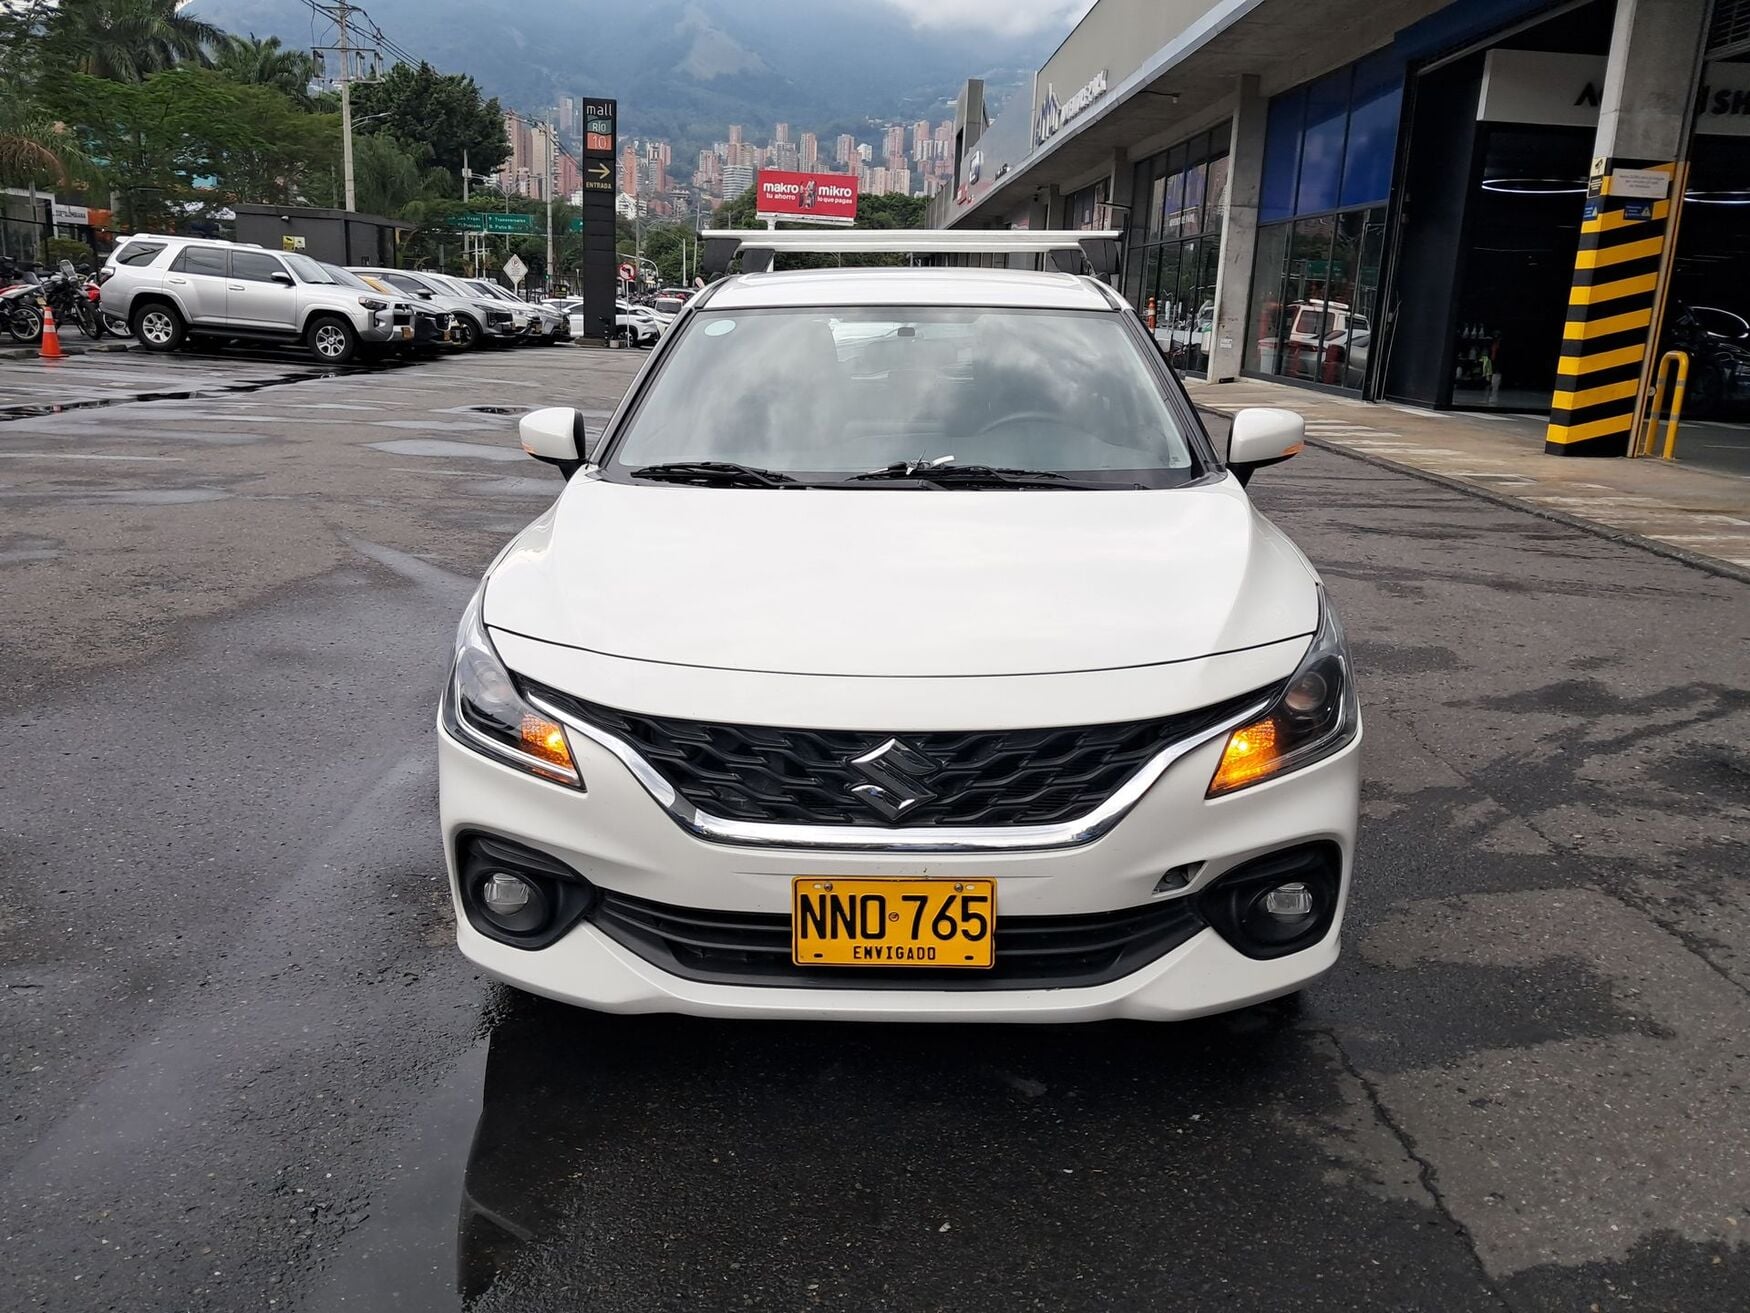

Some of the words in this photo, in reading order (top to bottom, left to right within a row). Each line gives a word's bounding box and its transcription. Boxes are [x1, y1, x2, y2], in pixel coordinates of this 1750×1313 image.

[586, 103, 613, 116] mall
[592, 135, 607, 149] 10
[586, 181, 612, 189] ENTRADA
[763, 182, 799, 194] makro
[818, 185, 852, 197] mikro
[901, 894, 989, 942] 765
[853, 945, 936, 961] ENVIGADO
